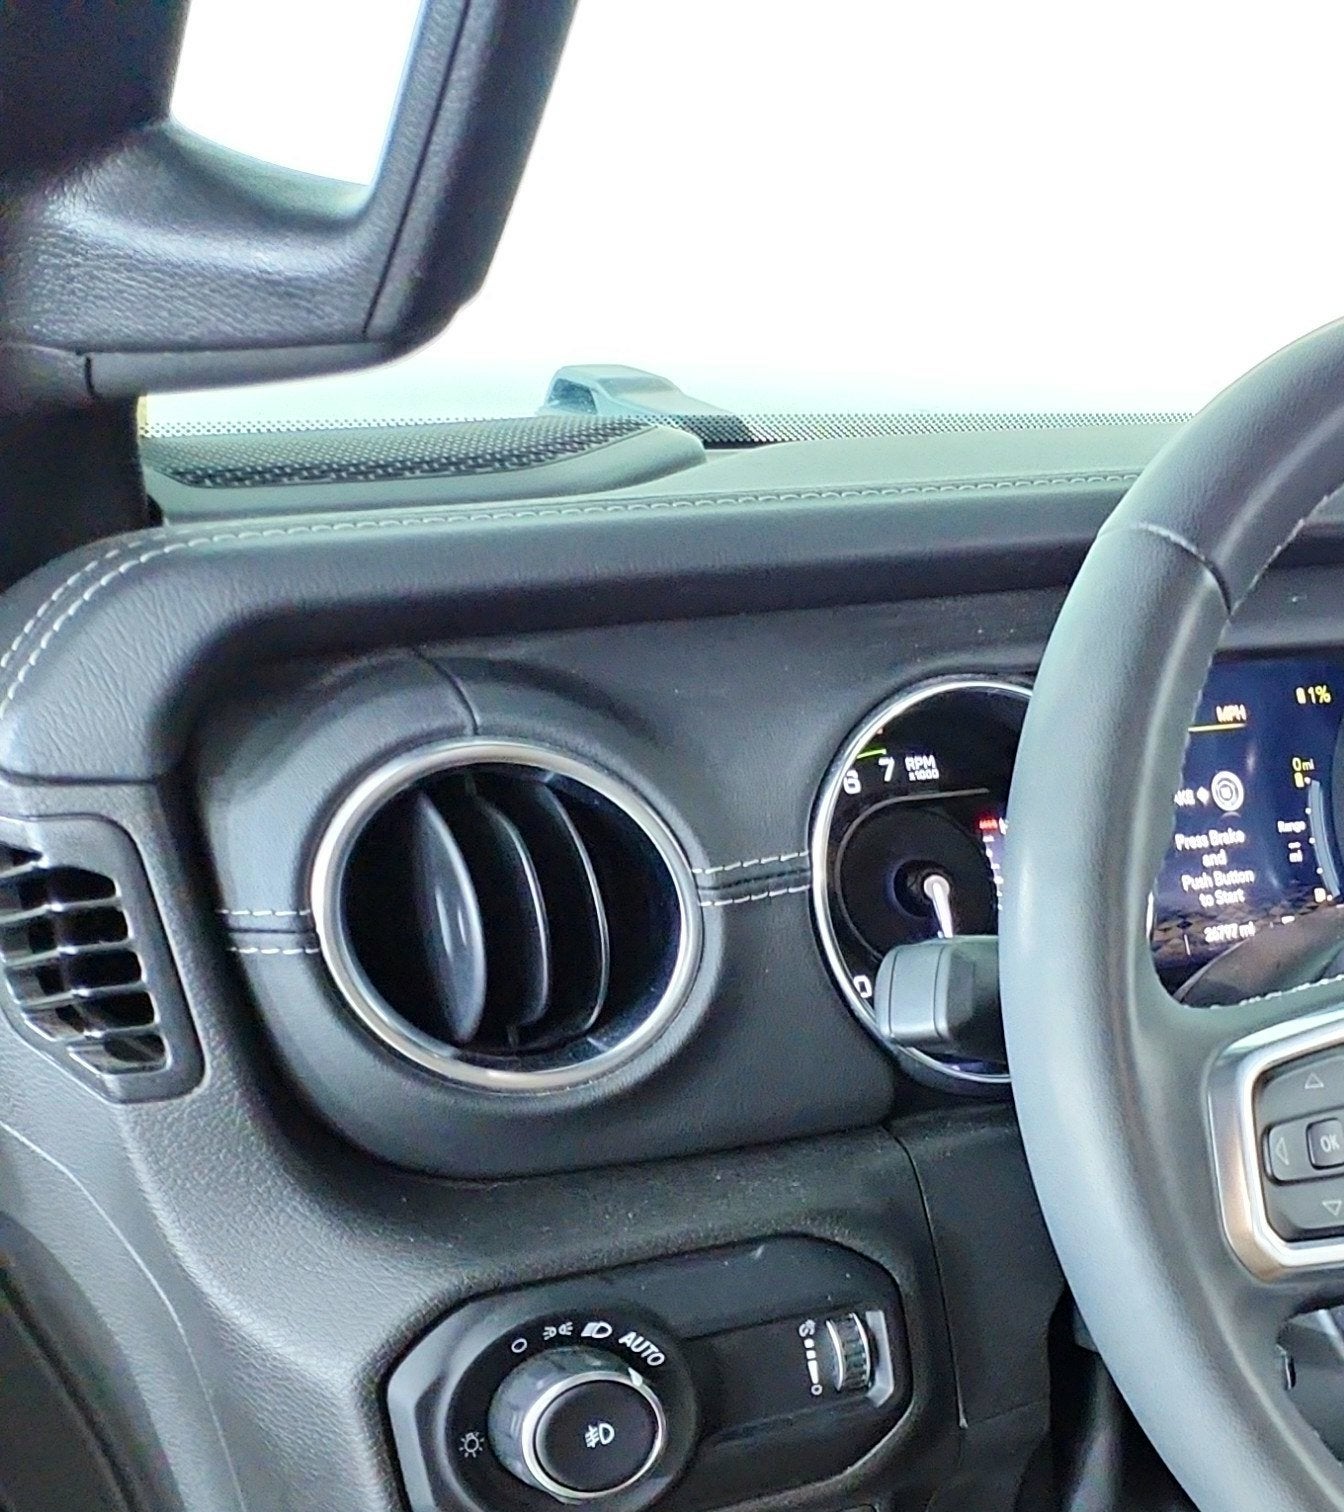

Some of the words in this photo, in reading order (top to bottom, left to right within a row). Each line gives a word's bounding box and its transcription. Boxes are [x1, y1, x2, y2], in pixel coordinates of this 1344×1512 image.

[1307, 685, 1331, 704] 1%
[1216, 704, 1247, 723] MPH
[878, 756, 895, 782] 7
[905, 754, 936, 771] RPM
[843, 769, 861, 795] 6
[1174, 832, 1209, 850] Press
[1209, 827, 1245, 847] Brake
[1202, 849, 1227, 867] and
[1181, 872, 1213, 891] Push
[1213, 869, 1255, 887] Button
[1199, 892, 1214, 907] to
[1214, 888, 1246, 906] Start
[854, 974, 872, 998] 0
[1320, 1133, 1340, 1152] OK
[618, 1330, 666, 1367] AUTO
